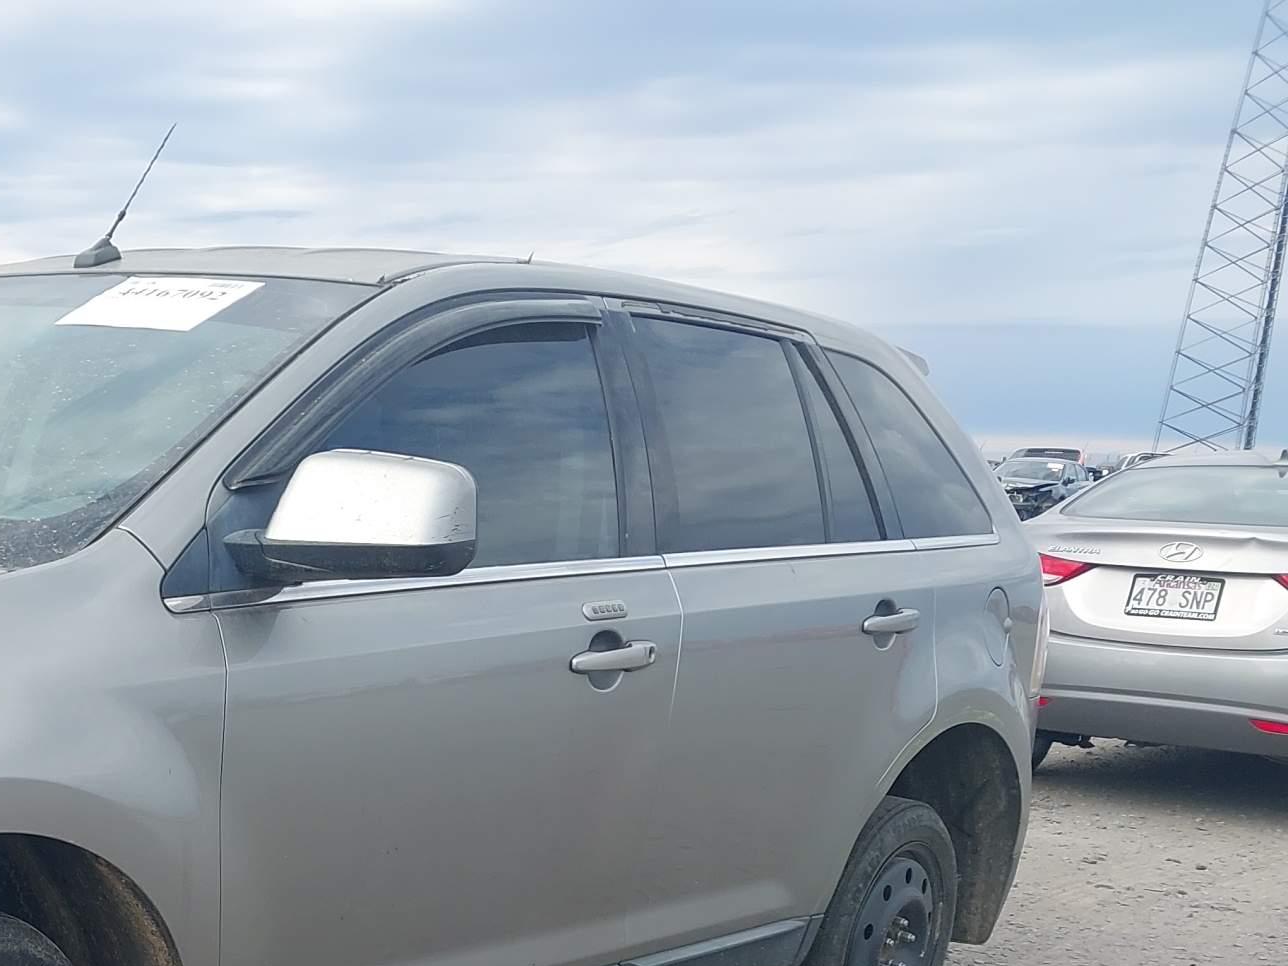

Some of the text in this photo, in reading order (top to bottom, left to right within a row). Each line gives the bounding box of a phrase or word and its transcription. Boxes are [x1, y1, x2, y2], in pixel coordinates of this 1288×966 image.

[1156, 574, 1202, 585] CRAIN
[1132, 587, 1214, 610] 478 SNP
